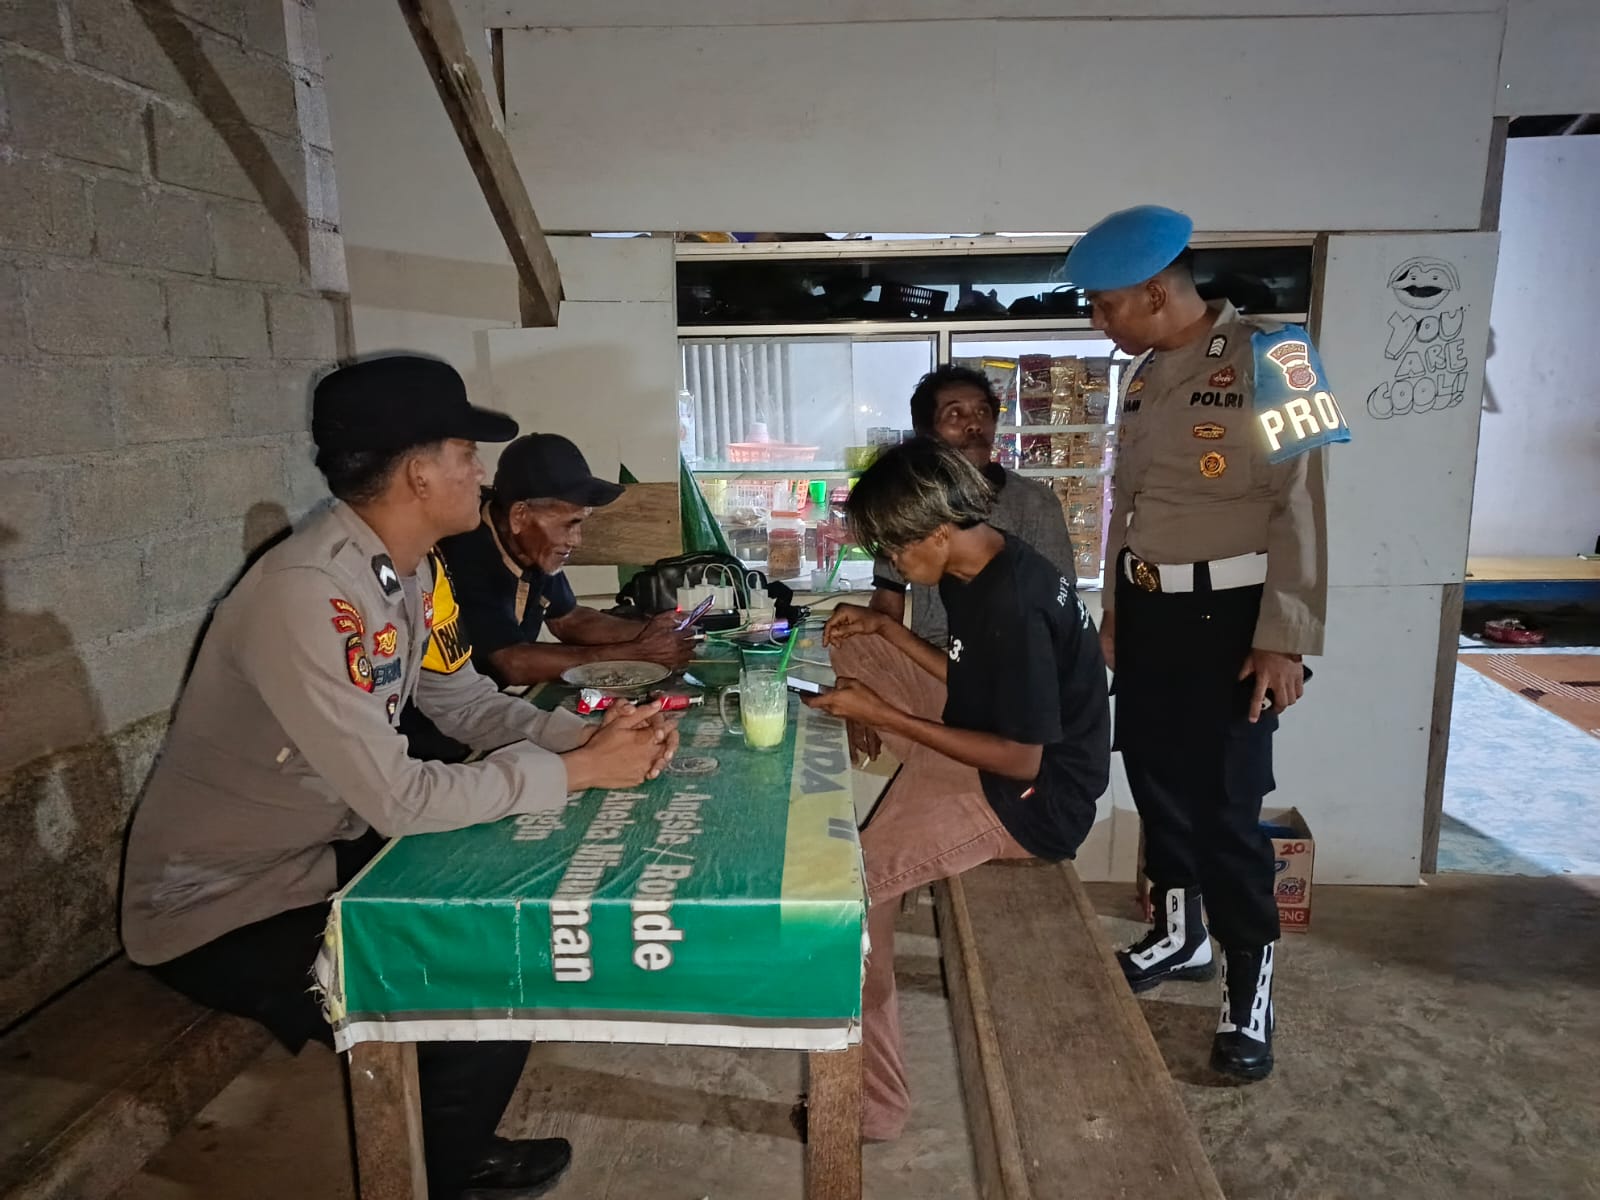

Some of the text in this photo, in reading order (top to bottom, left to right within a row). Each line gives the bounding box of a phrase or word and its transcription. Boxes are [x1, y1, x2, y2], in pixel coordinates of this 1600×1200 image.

[1385, 311, 1464, 360] YOU
[1395, 338, 1468, 379] ARE
[1189, 391, 1245, 409] POLRI
[1259, 391, 1348, 451] PRO
[655, 791, 713, 845] Angsle
[1280, 843, 1305, 856] 20
[550, 791, 651, 982] Aneka Minuman
[632, 864, 693, 971] Ronde
[1279, 911, 1305, 922] ENG
